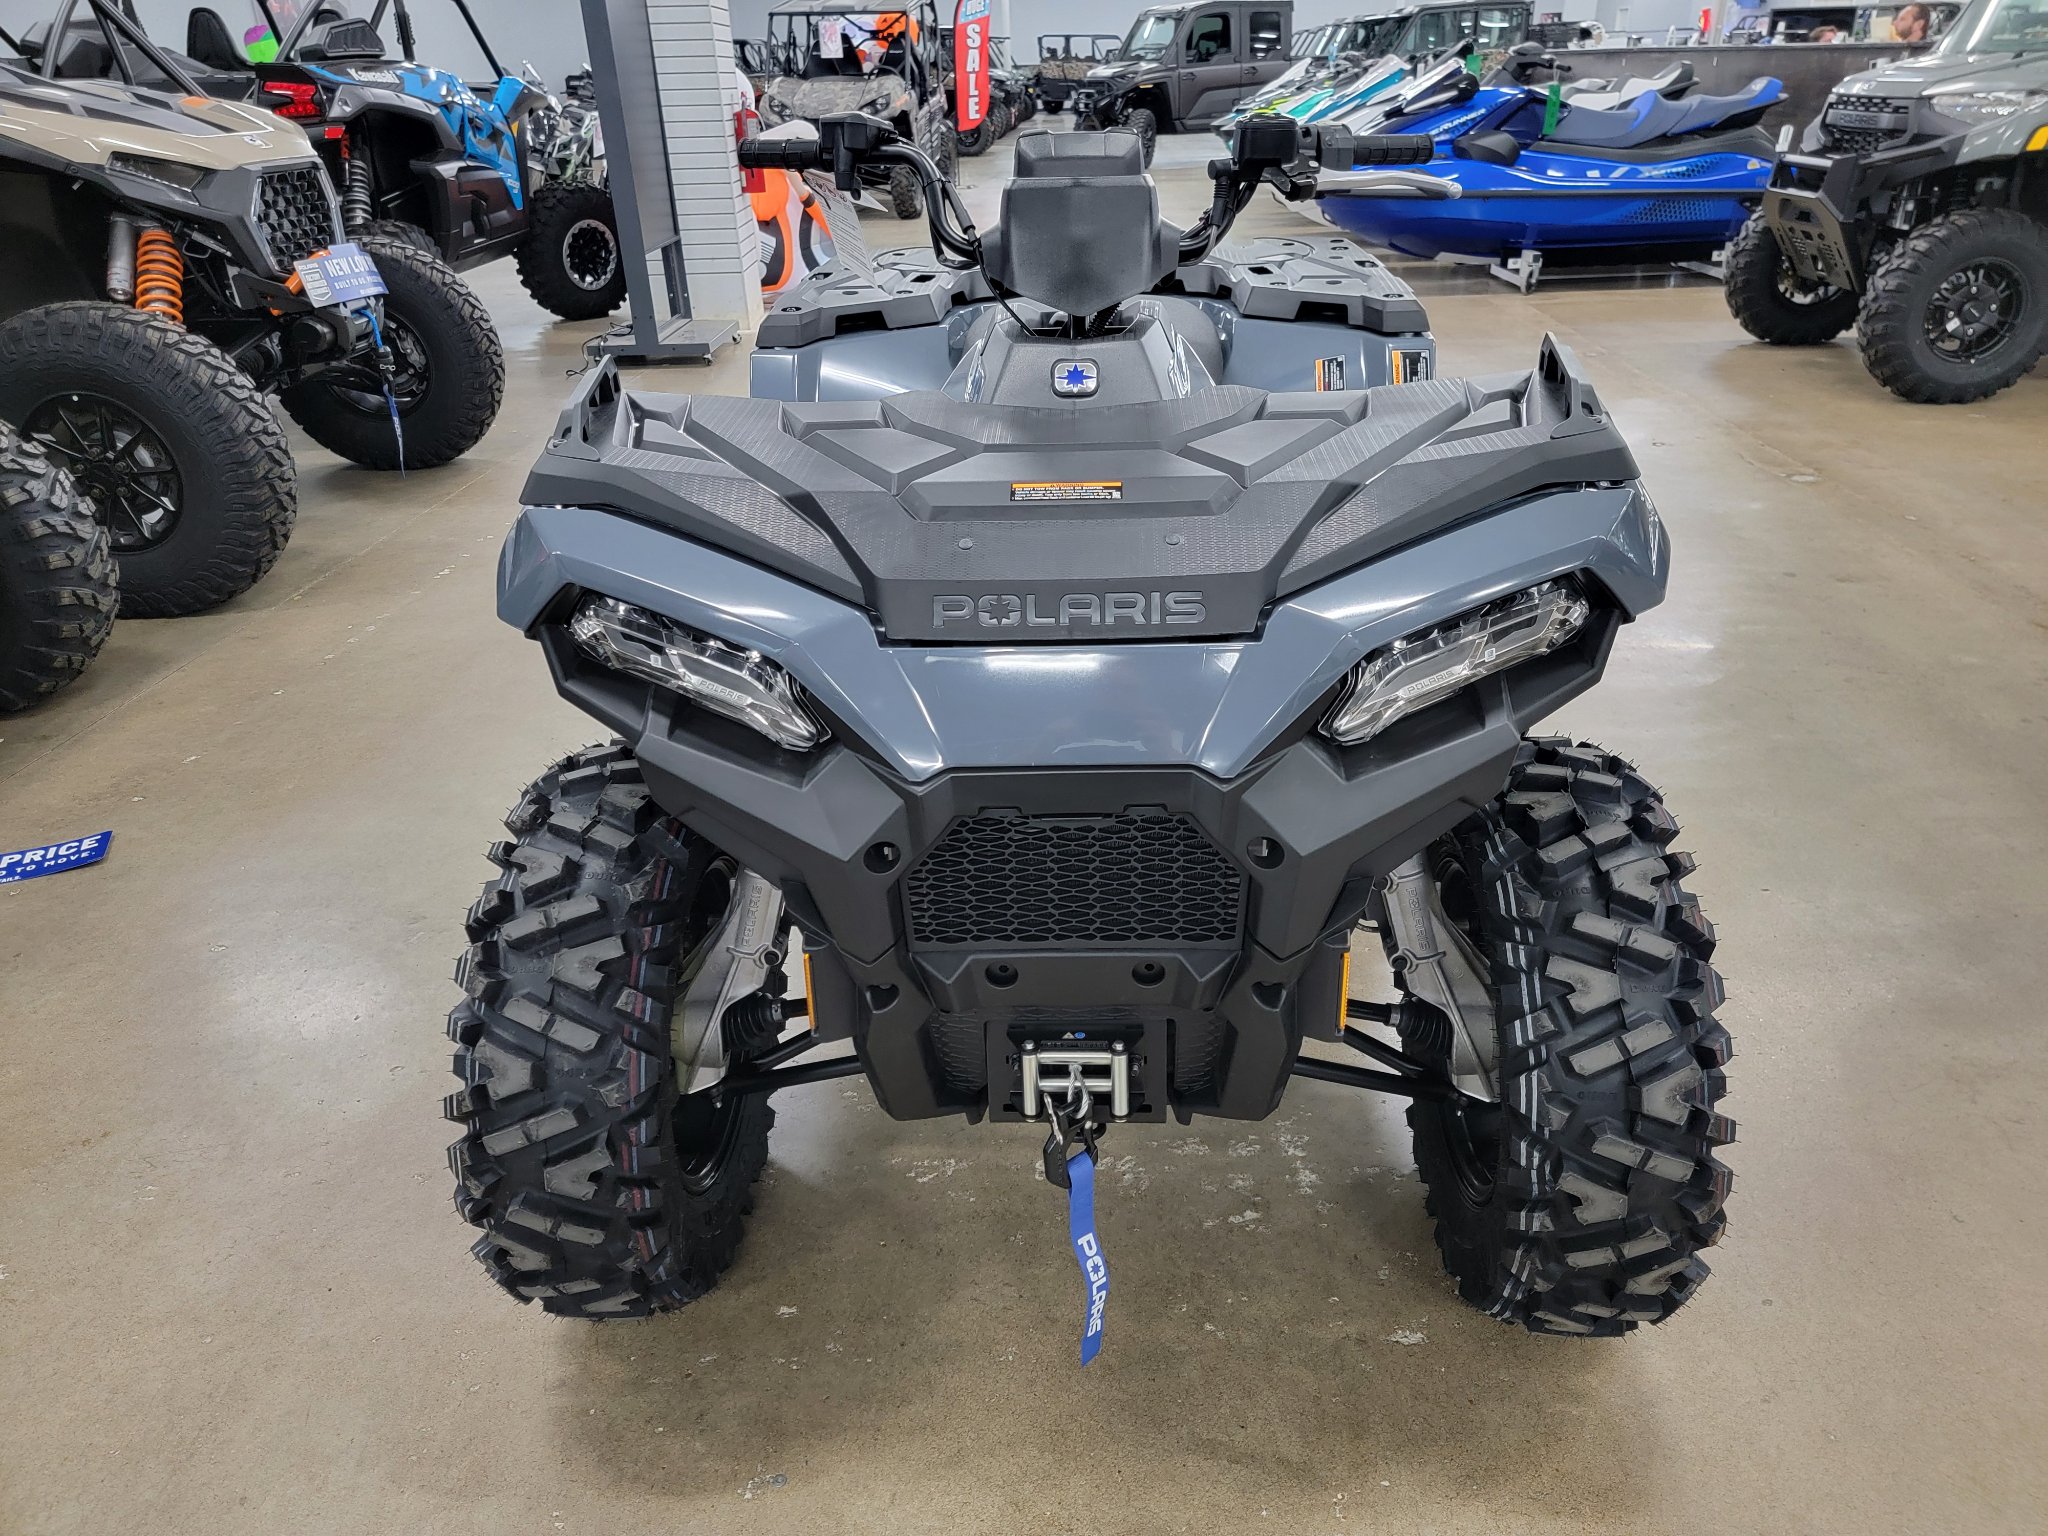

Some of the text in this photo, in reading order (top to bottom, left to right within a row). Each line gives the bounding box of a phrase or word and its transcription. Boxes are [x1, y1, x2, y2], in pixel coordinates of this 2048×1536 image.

[966, 24, 981, 120] SALE
[324, 258, 352, 278] NEW
[932, 591, 1207, 629] POLARIS
[699, 679, 746, 701] POLARIS
[1406, 670, 1455, 694] POLARIS
[0, 835, 102, 869] PRICE
[16, 864, 36, 873] TO
[742, 884, 763, 947] POLARIS
[1406, 887, 1431, 952] POLARIS
[1078, 1232, 1107, 1338] POLARIS
